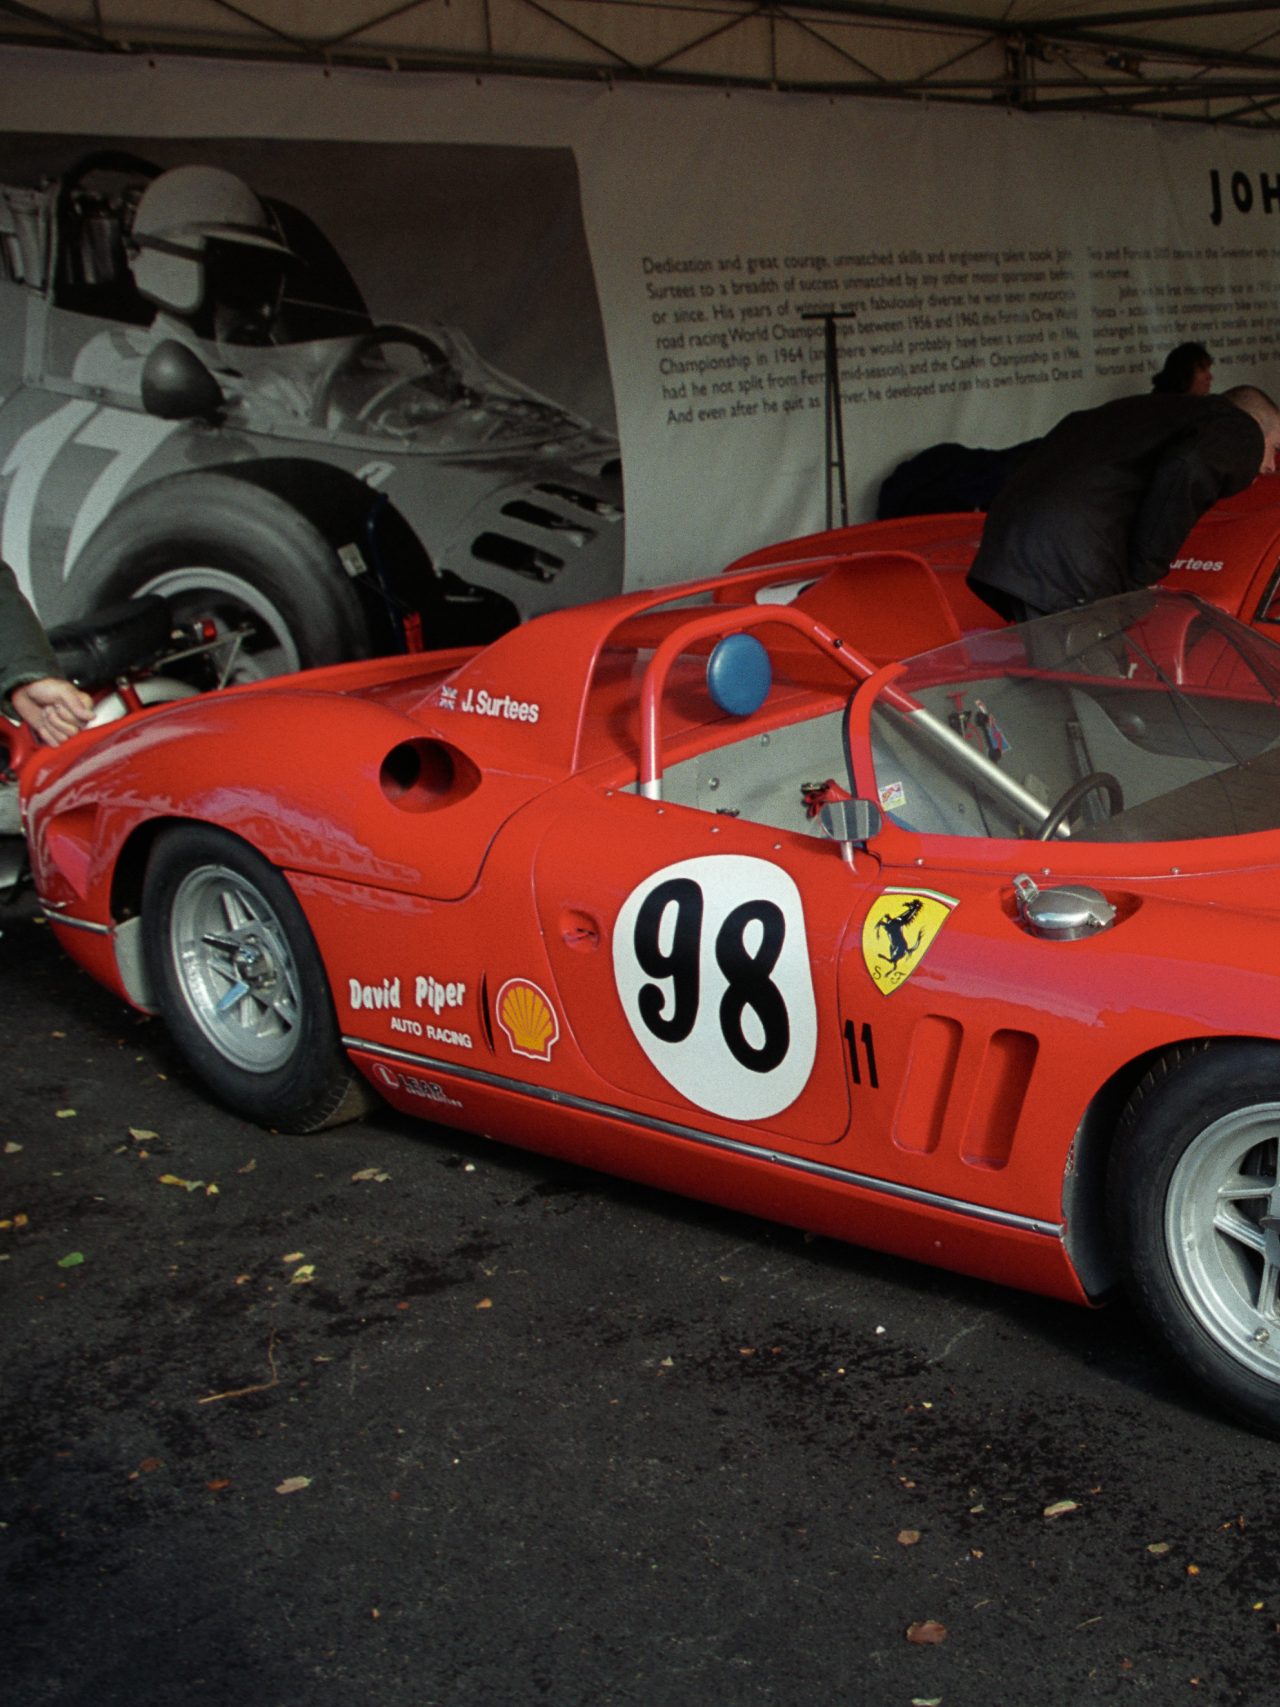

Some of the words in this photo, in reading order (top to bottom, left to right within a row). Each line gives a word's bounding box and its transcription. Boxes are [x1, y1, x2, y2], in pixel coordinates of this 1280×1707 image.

[643, 257, 712, 274] Dedication
[719, 255, 741, 271] and
[748, 256, 778, 273] great
[834, 250, 893, 265] unmatched
[647, 284, 696, 299] Surtees
[700, 284, 714, 296] to
[720, 285, 726, 295] a
[732, 278, 778, 295] breadth
[784, 277, 795, 292] of
[800, 280, 838, 291] success
[843, 273, 902, 288] unmatched
[652, 313, 667, 323] or
[713, 305, 735, 320] His
[740, 306, 772, 322] years
[777, 301, 789, 315] of
[841, 301, 866, 311] were
[870, 294, 924, 311] fabulously
[657, 332, 684, 348] road
[689, 330, 728, 348] racing
[729, 326, 769, 343] World
[773, 321, 854, 342] Champioips
[857, 319, 903, 333] between
[936, 314, 952, 328] and
[1032, 309, 1053, 322] One
[660, 353, 751, 375] Championship
[756, 351, 768, 366] in
[774, 349, 803, 364] 1964
[809, 347, 825, 363] (an
[837, 344, 866, 358] here
[870, 339, 903, 356] would
[909, 336, 951, 355] probably
[663, 382, 685, 399] had
[692, 381, 706, 396] he
[712, 380, 732, 394] not
[739, 375, 763, 394] split
[768, 373, 797, 388] from
[801, 371, 825, 385] Ferr
[910, 359, 928, 375] and
[931, 358, 947, 372] the
[668, 407, 692, 424] And
[698, 409, 726, 421] even
[731, 403, 758, 418] after
[763, 400, 777, 414] he
[783, 396, 805, 415] quit
[809, 398, 820, 408] as
[868, 387, 881, 401] he
[885, 381, 935, 399] developed
[939, 378, 956, 393] and
[1051, 369, 1069, 382] One
[2, 399, 181, 628] 17
[1169, 557, 1224, 571] urtees
[349, 976, 400, 1010] David
[415, 975, 466, 1015] Piper
[634, 878, 790, 1073] 98
[390, 1016, 422, 1037] AUTO
[426, 1025, 473, 1049] RACING
[844, 1019, 879, 1089] 11
